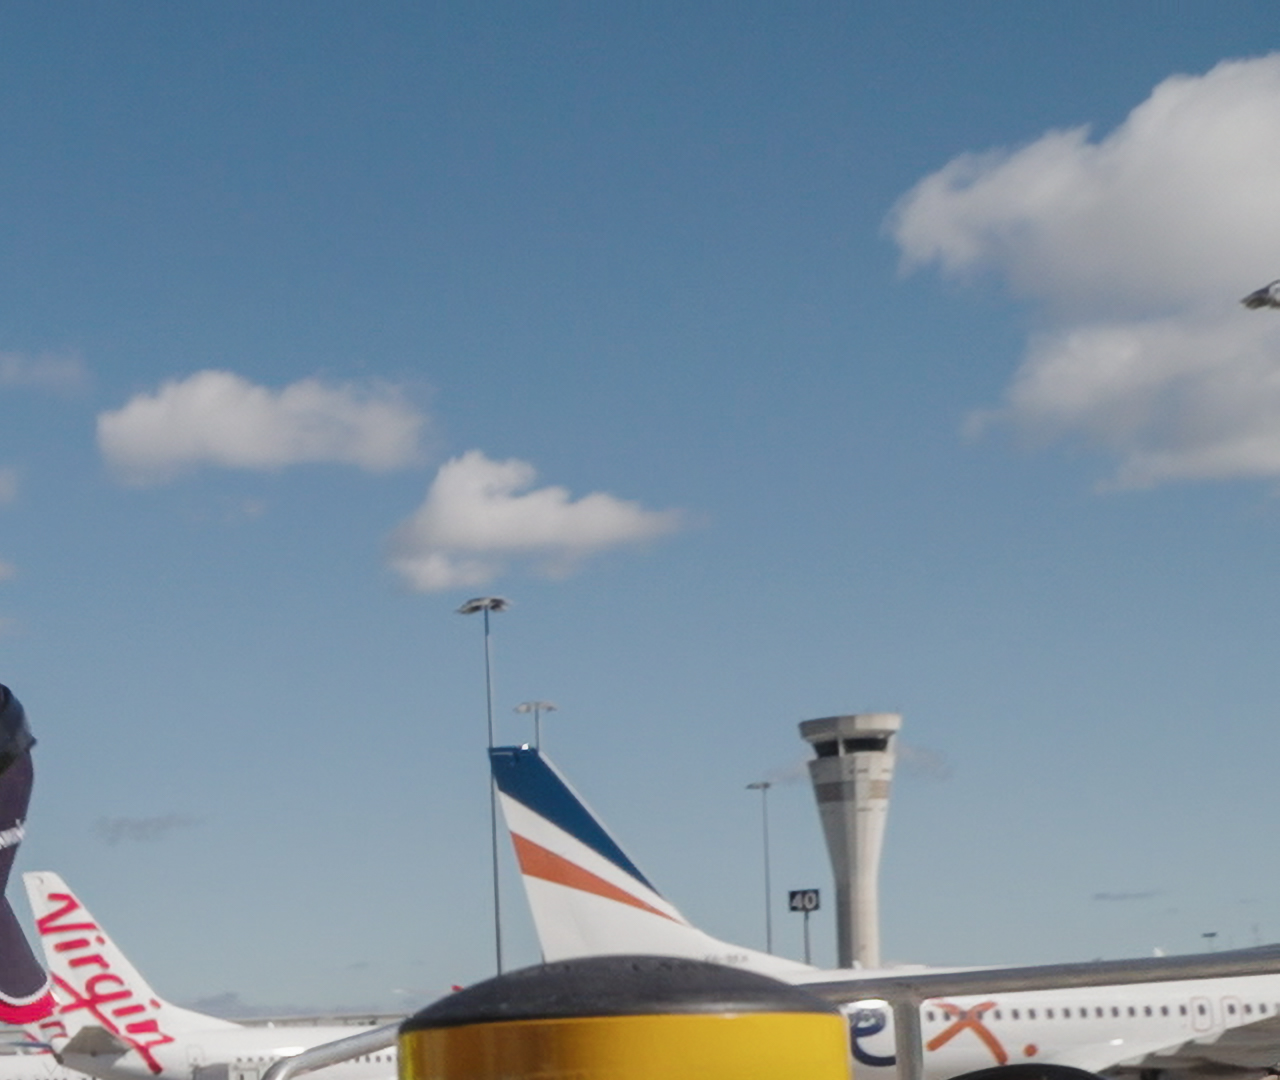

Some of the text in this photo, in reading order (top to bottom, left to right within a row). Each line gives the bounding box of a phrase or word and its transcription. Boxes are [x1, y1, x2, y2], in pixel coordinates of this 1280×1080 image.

[792, 893, 817, 909] 40
[35, 892, 175, 1074] Virgin
[850, 1001, 1039, 1067] ex.
